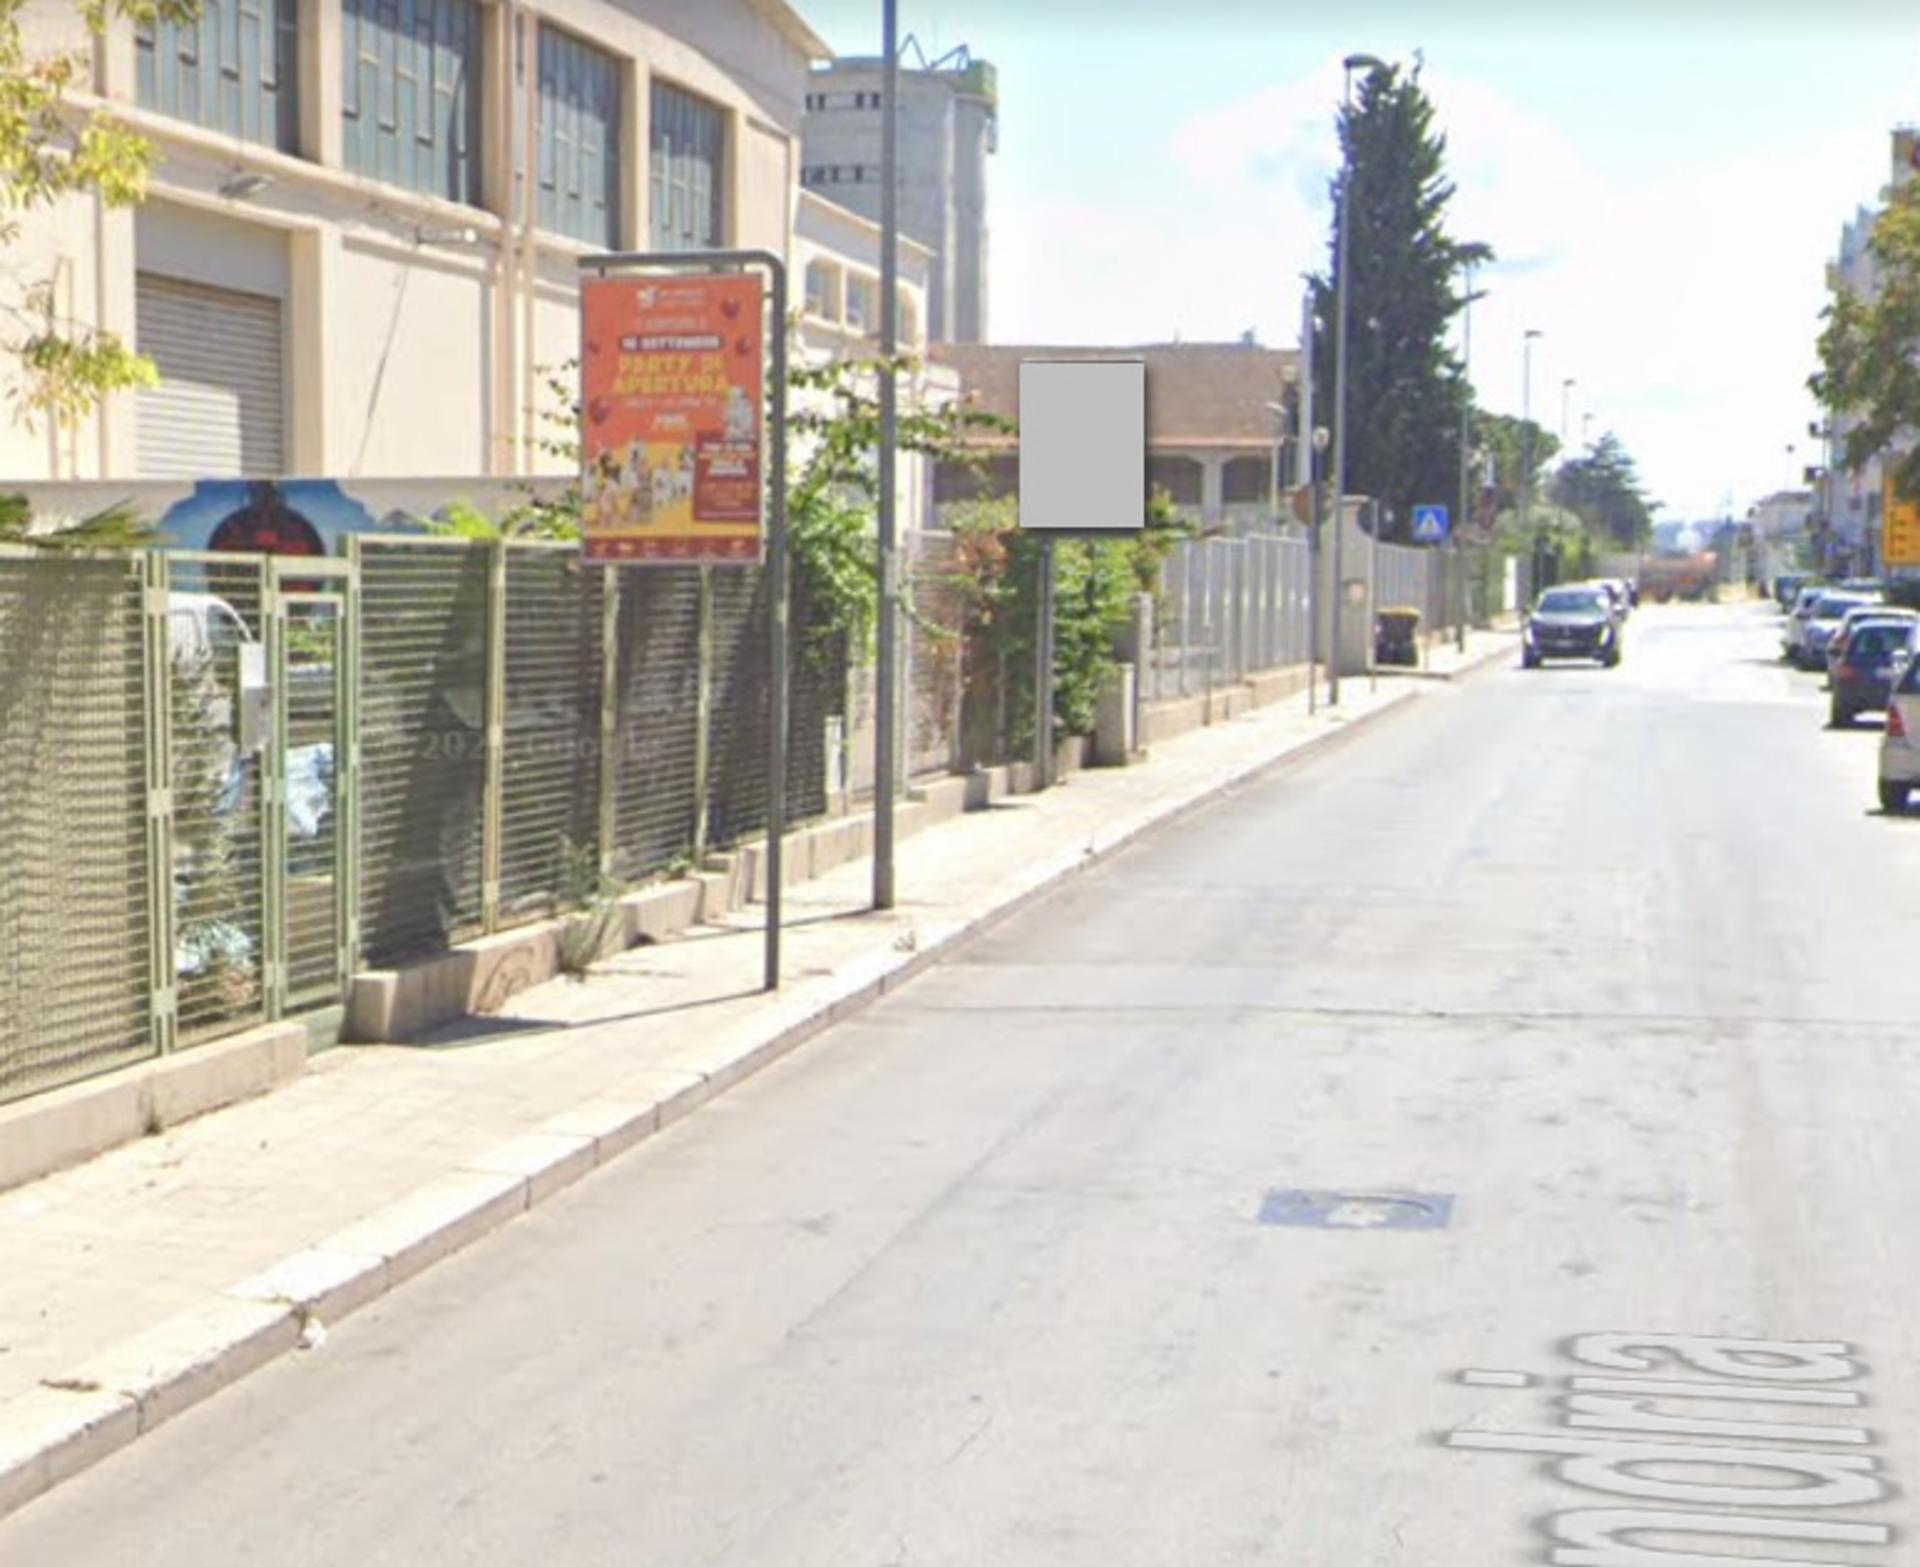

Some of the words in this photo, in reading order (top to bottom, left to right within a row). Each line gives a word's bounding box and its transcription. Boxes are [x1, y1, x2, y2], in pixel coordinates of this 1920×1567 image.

[618, 354, 691, 374] PARTY
[701, 354, 728, 374] DI
[612, 374, 730, 394] APERTURA
